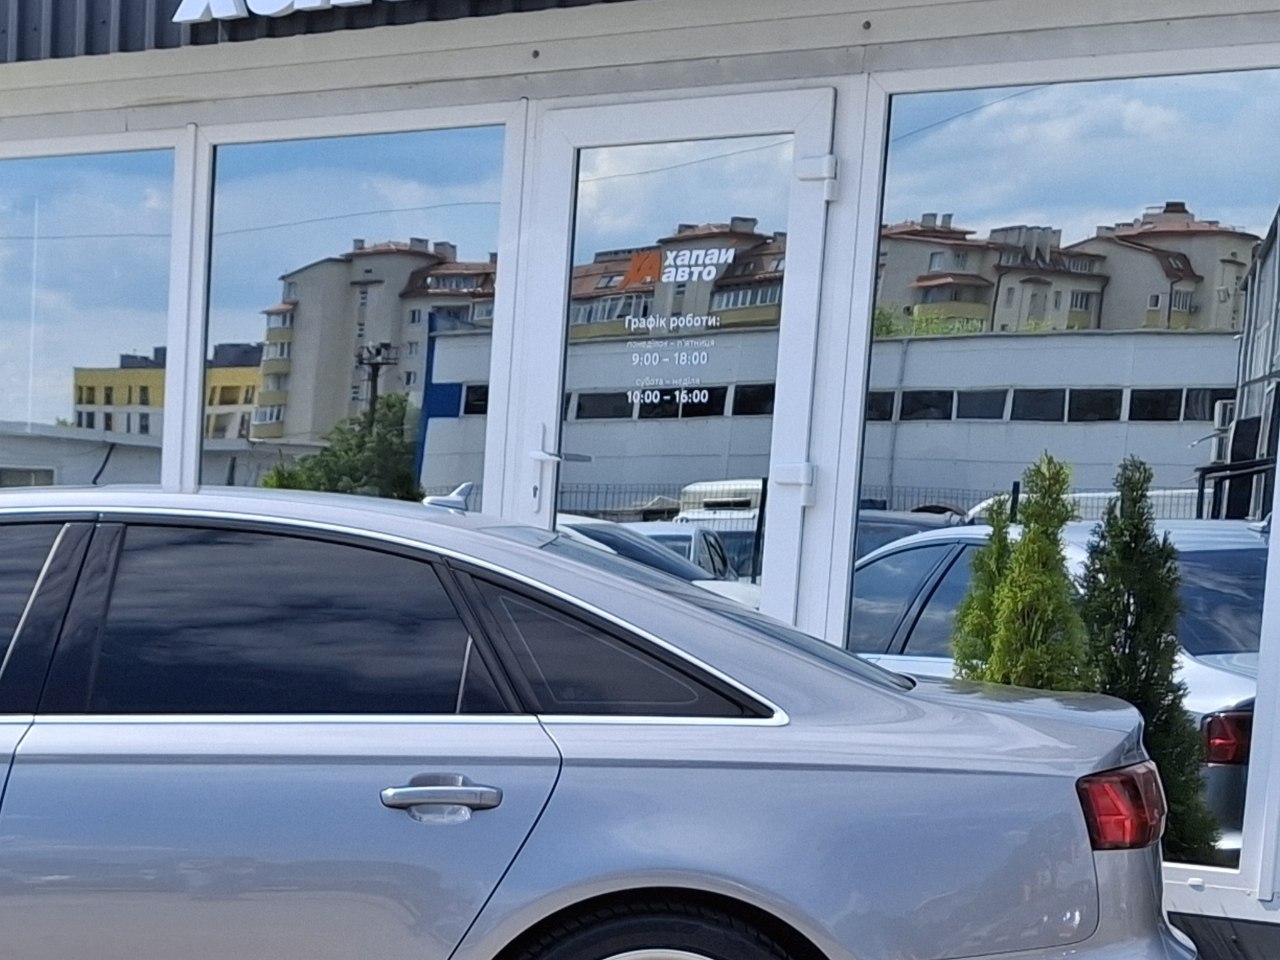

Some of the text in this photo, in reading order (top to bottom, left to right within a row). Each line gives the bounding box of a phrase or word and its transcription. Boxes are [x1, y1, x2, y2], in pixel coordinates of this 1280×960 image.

[662, 265, 717, 283] авто
[625, 313, 720, 332] Графік роботи:
[632, 352, 660, 366] 9:00
[674, 351, 708, 365] 18:00
[627, 390, 660, 404] 10:00
[674, 389, 709, 403] 16:00
